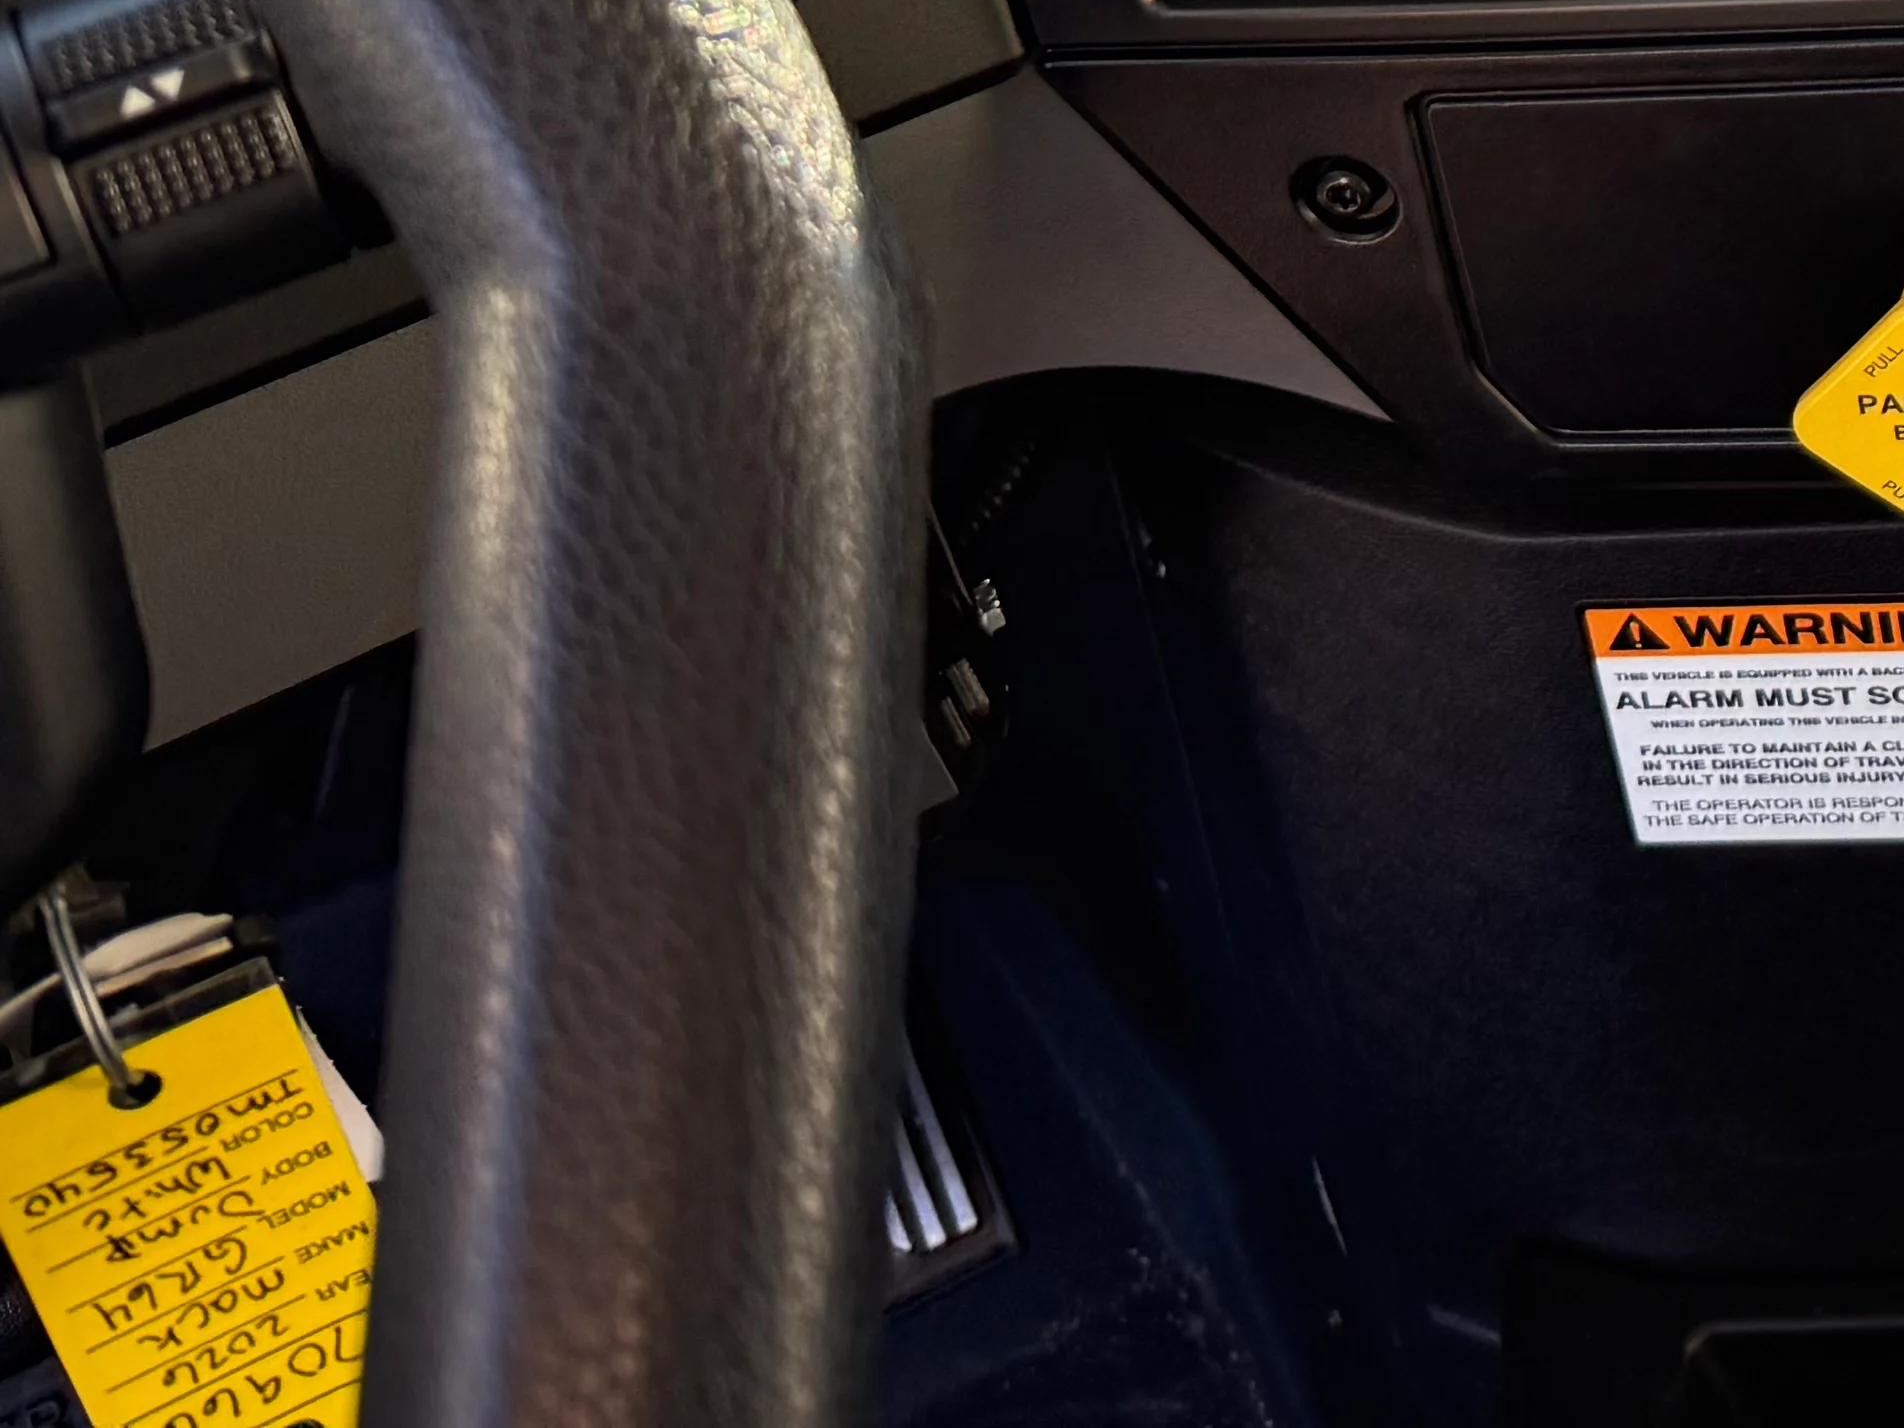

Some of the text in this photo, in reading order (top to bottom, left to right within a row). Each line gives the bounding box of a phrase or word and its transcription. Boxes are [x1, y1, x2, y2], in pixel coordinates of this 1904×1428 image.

[1863, 347, 1904, 379] PULL
[1616, 689, 1745, 710] ALARM
[1755, 687, 1856, 707] MUST
[1639, 744, 1725, 756] FAILURE
[1729, 743, 1757, 754] TO
[1762, 741, 1857, 754] MAINTAIN
[1863, 741, 1877, 752] A
[1643, 759, 1662, 771] IN
[1666, 758, 1707, 771] THE
[1711, 757, 1818, 770] DIRECTION
[1823, 756, 1851, 768] OF
[1637, 773, 1714, 786] RESULT
[1719, 773, 1739, 785] IN
[1744, 772, 1832, 785] SERIOUS
[1644, 815, 1684, 827] THE
[1687, 813, 1739, 826] SAFE
[1743, 811, 1855, 825] OPERATION
[1860, 812, 1887, 823] OF
[1652, 799, 1692, 812] THE
[1696, 797, 1803, 811] OPERATOR
[1808, 797, 1827, 809] IS
[219, 1101, 315, 1153] COLOR
[260, 1140, 334, 1186] BODY
[256, 1180, 352, 1229] MODEL
[293, 1220, 370, 1265] MAKE
[315, 1268, 372, 1302] EAR
[162, 1314, 291, 1387] 2026
